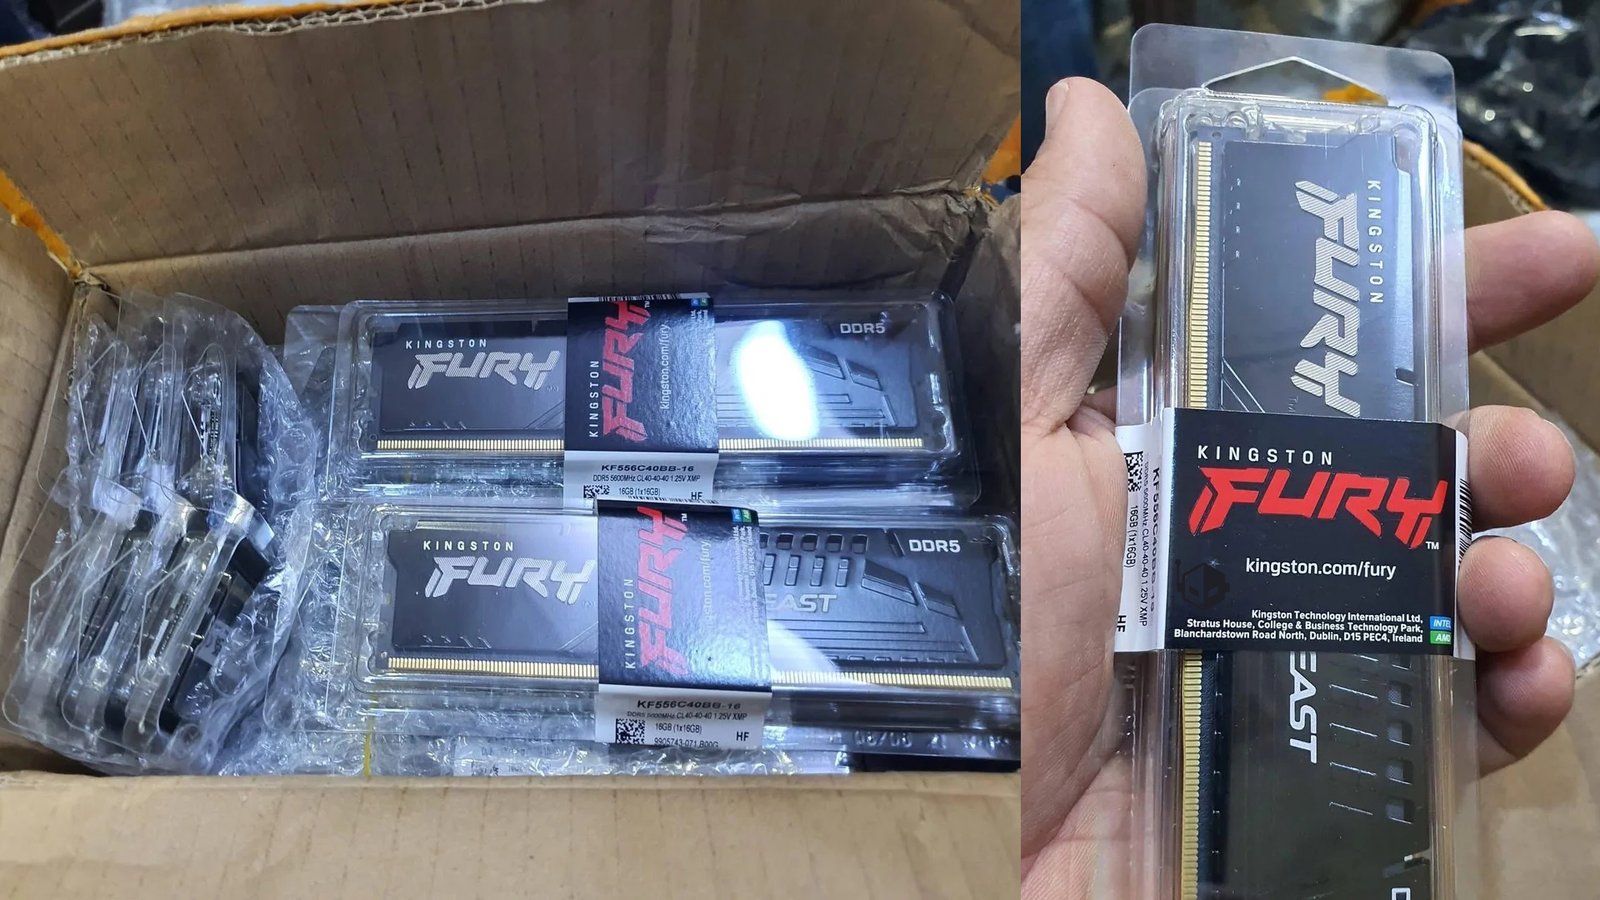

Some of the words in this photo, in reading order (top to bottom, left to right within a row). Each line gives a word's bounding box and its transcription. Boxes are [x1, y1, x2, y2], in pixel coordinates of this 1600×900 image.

[1367, 180, 1384, 303] KINGSTON
[1290, 180, 1361, 418] FURY
[840, 322, 886, 334] DDR5
[405, 338, 488, 349] KINGSTON
[407, 350, 560, 390] FURY
[601, 300, 651, 443] FURY
[659, 324, 671, 410] kingston.com/fury
[589, 360, 600, 438] KINGSTON
[1198, 445, 1333, 466] KINGSTON
[601, 464, 694, 472] KF556C40BB-16
[619, 487, 633, 495] 16GB
[635, 487, 661, 496] (1x16GB)
[691, 491, 703, 500] HF
[1129, 504, 1138, 527] 16GB
[1188, 466, 1448, 549] FURY
[423, 540, 514, 552] KINGSTON
[909, 539, 961, 553] DDR5
[1124, 528, 1137, 568] (1x16GB)
[1141, 528, 1150, 578] CL40-40-40
[1246, 557, 1396, 580] kingston.com/fury
[425, 556, 597, 605] FURY
[636, 505, 689, 677] FURY
[765, 593, 837, 613] EAST
[624, 578, 636, 669] KINGSTON
[1138, 606, 1148, 627] XMP
[1187, 618, 1221, 628] Stratus
[1223, 619, 1256, 629] House,
[1257, 620, 1294, 631] College
[1295, 621, 1302, 629] &
[1305, 622, 1345, 631] Business
[1348, 622, 1398, 634] Technology
[1401, 623, 1423, 633] Park,
[1251, 609, 1292, 620] Kingston
[1294, 610, 1346, 622] Technology
[1348, 612, 1405, 622] International
[1174, 628, 1250, 639] Blanchardstown
[1252, 630, 1277, 639] Road
[1278, 630, 1307, 641] North,
[1310, 631, 1342, 642] Dublin,
[1344, 632, 1361, 641] D15
[1363, 632, 1390, 643] PEC4,
[1392, 634, 1423, 643] Ireland
[637, 700, 741, 710] KF556C40BB-16
[1289, 650, 1317, 764] EAST
[655, 722, 672, 731] 16GB
[673, 723, 702, 734] (1x16GB)
[736, 732, 750, 742] HF
